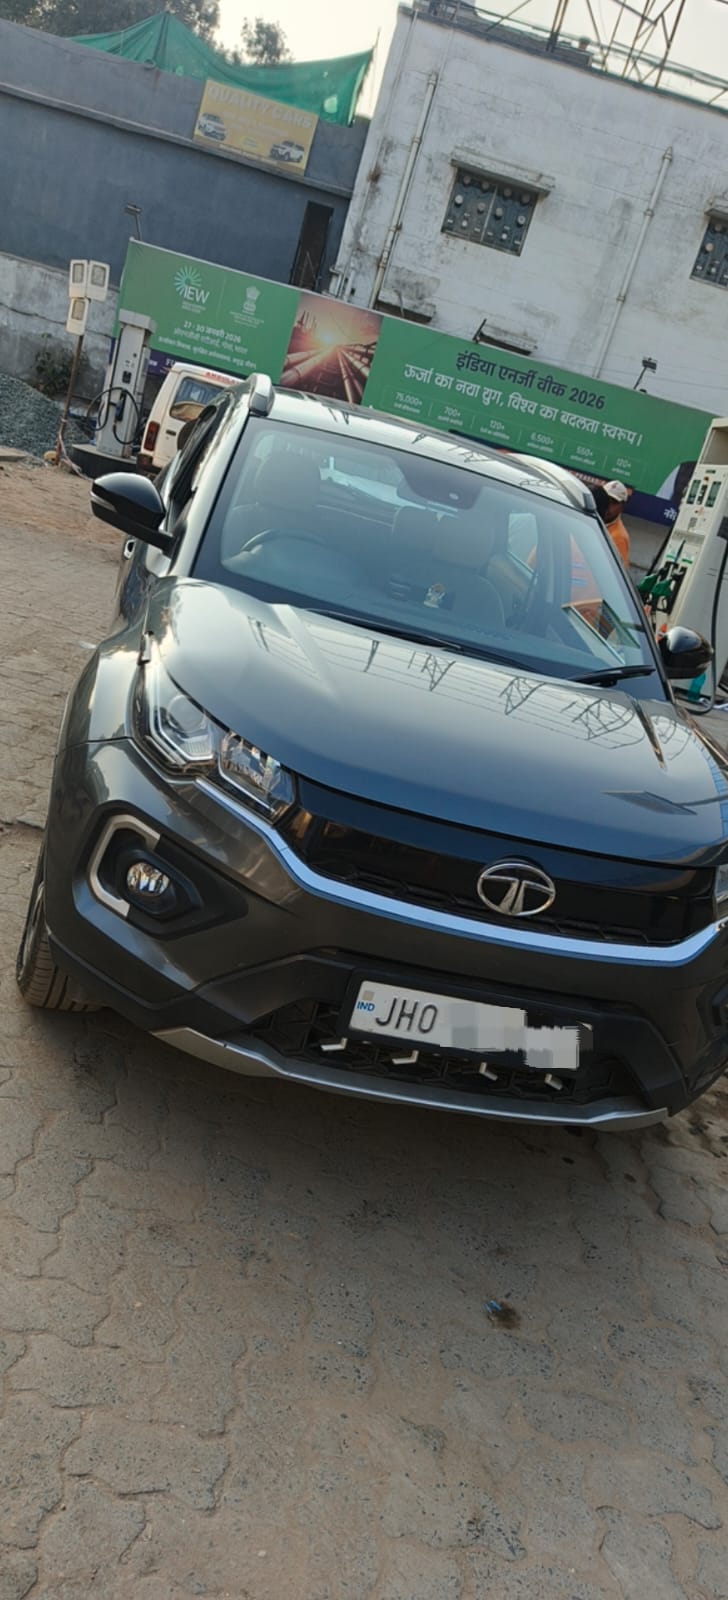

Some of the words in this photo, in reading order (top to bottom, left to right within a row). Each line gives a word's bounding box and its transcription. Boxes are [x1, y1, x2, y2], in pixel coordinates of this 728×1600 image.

[208, 86, 271, 113] QUALITY
[272, 107, 312, 129] CARS
[184, 286, 210, 303] IEW
[225, 331, 242, 344] 2026
[455, 350, 497, 377] इंडिया
[498, 366, 538, 389] एनर्जी
[537, 375, 568, 397] वीक
[569, 387, 606, 410] 2026
[404, 363, 433, 385] ऊर्जा
[434, 374, 453, 391] का
[455, 379, 480, 398] नया
[482, 386, 504, 407] युग,
[507, 391, 539, 415] विश्व
[539, 404, 558, 421] का
[560, 410, 601, 433] बदलता
[443, 406, 462, 418] 700+
[489, 420, 505, 431] 120+
[356, 1001, 376, 1013] IND
[375, 997, 439, 1034] JH0
